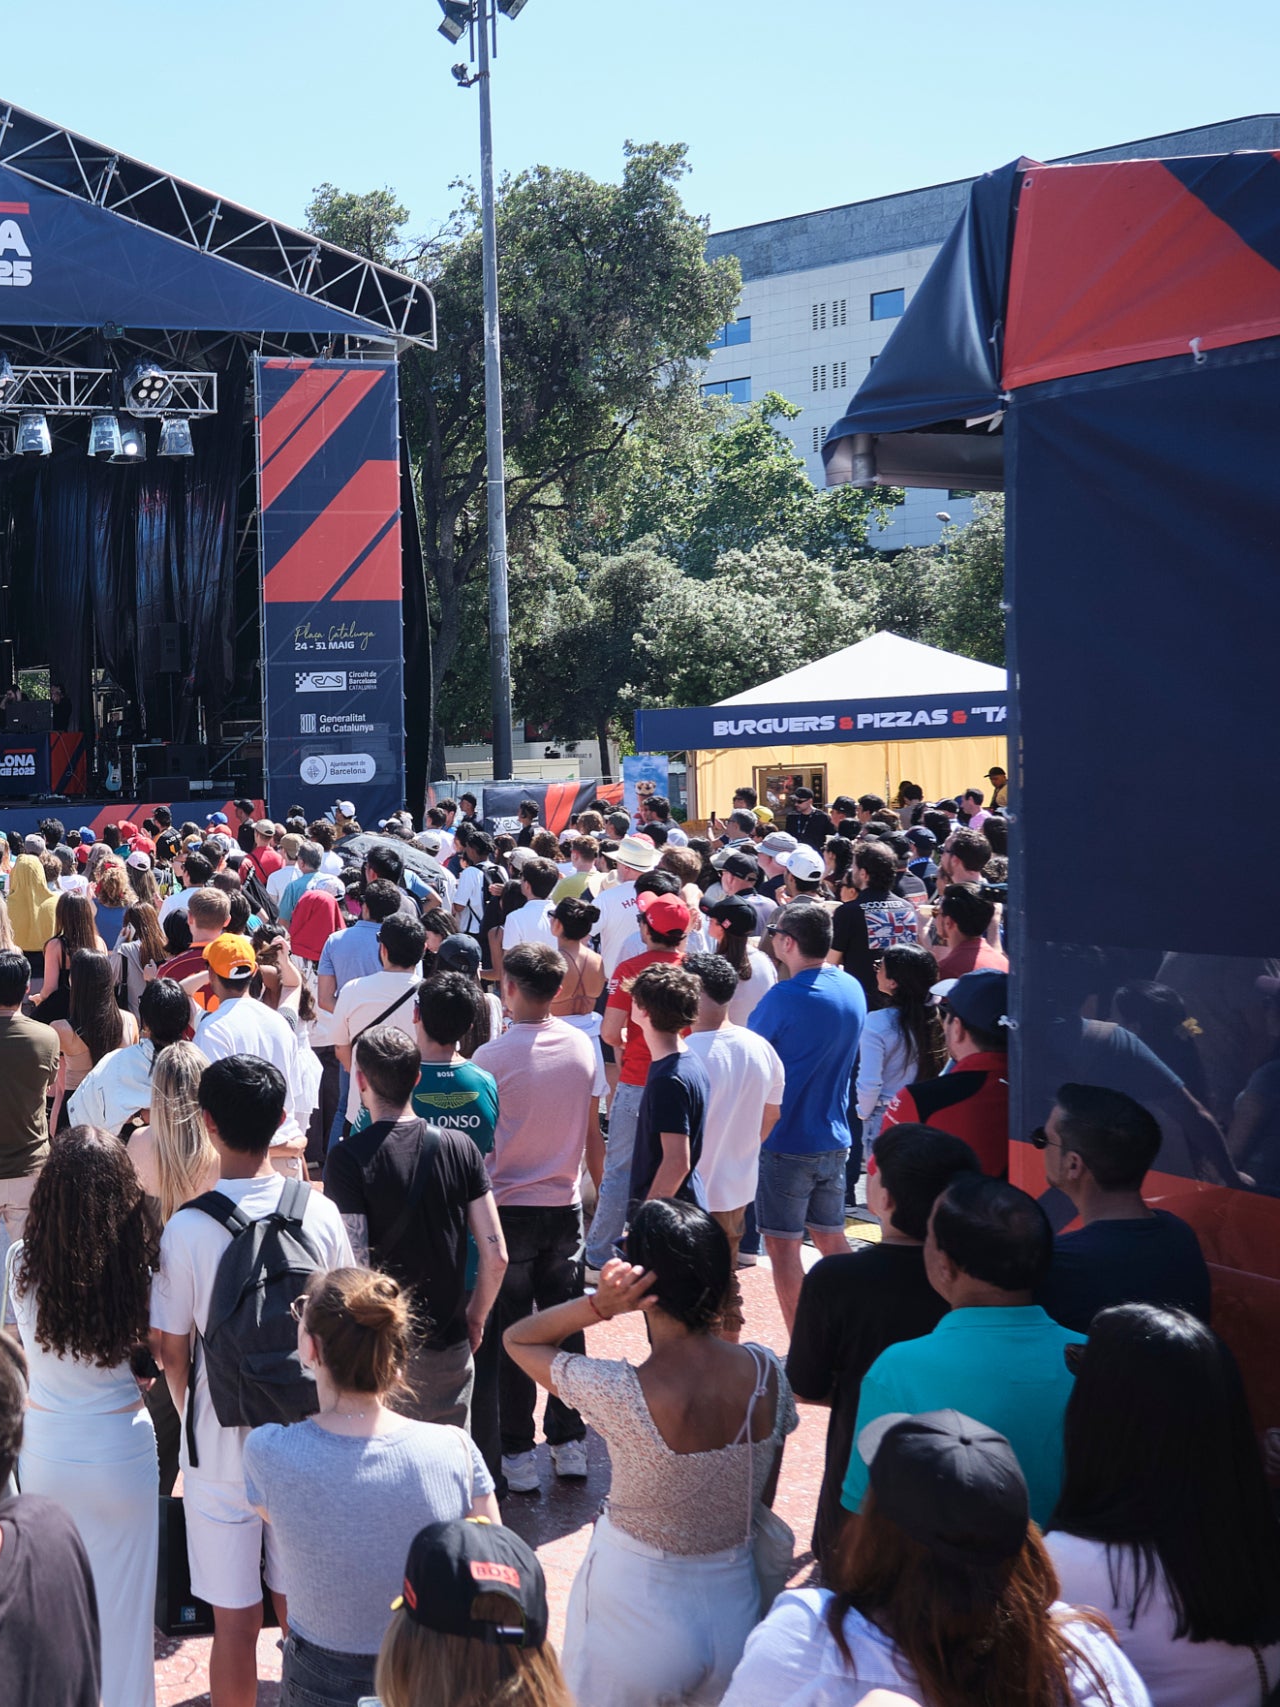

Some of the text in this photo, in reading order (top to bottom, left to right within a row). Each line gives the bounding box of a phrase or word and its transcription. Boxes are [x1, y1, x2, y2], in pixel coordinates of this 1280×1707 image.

[294, 620, 376, 651] Plaça Catalunya
[295, 641, 354, 650] 24 31 MAIG
[319, 714, 366, 723] Generalitat
[713, 715, 836, 736] BURGUERS
[839, 716, 853, 730] &
[857, 709, 949, 729] PIZZAS
[951, 710, 968, 724] &
[319, 723, 374, 733] de Catalunya
[330, 760, 358, 768] Ajuntament
[12, 767, 35, 776] 2025
[330, 767, 366, 775] Barcelona
[860, 901, 905, 910] SCOOTER
[430, 1115, 480, 1128] LONSO
